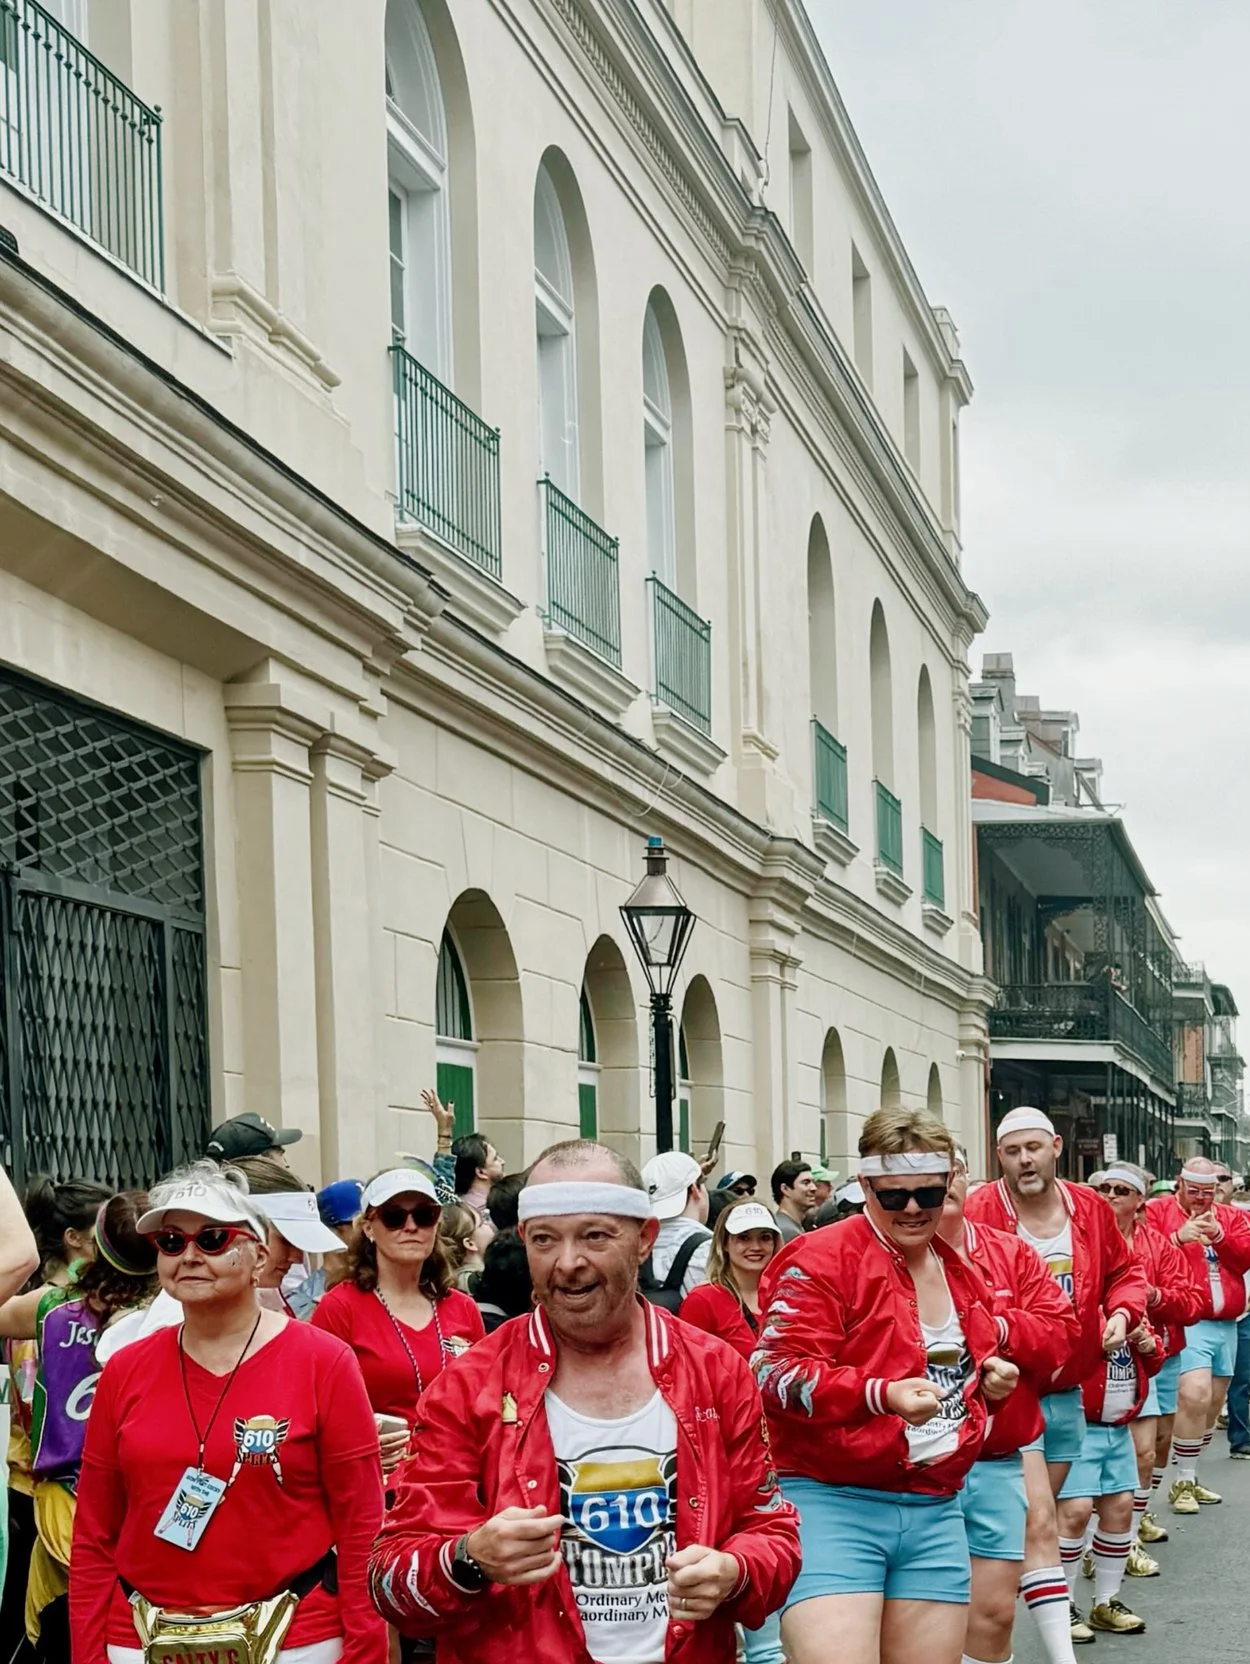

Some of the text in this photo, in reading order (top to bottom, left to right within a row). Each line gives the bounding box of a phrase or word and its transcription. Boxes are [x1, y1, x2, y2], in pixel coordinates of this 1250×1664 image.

[1057, 1274, 1073, 1296] 10
[244, 1430, 274, 1447] 610
[180, 1502, 199, 1518] 610
[581, 1491, 662, 1533] 610
[561, 1532, 677, 1588] TOMPE
[575, 1590, 668, 1608] Ordinary Me
[581, 1609, 649, 1623] aordinary
